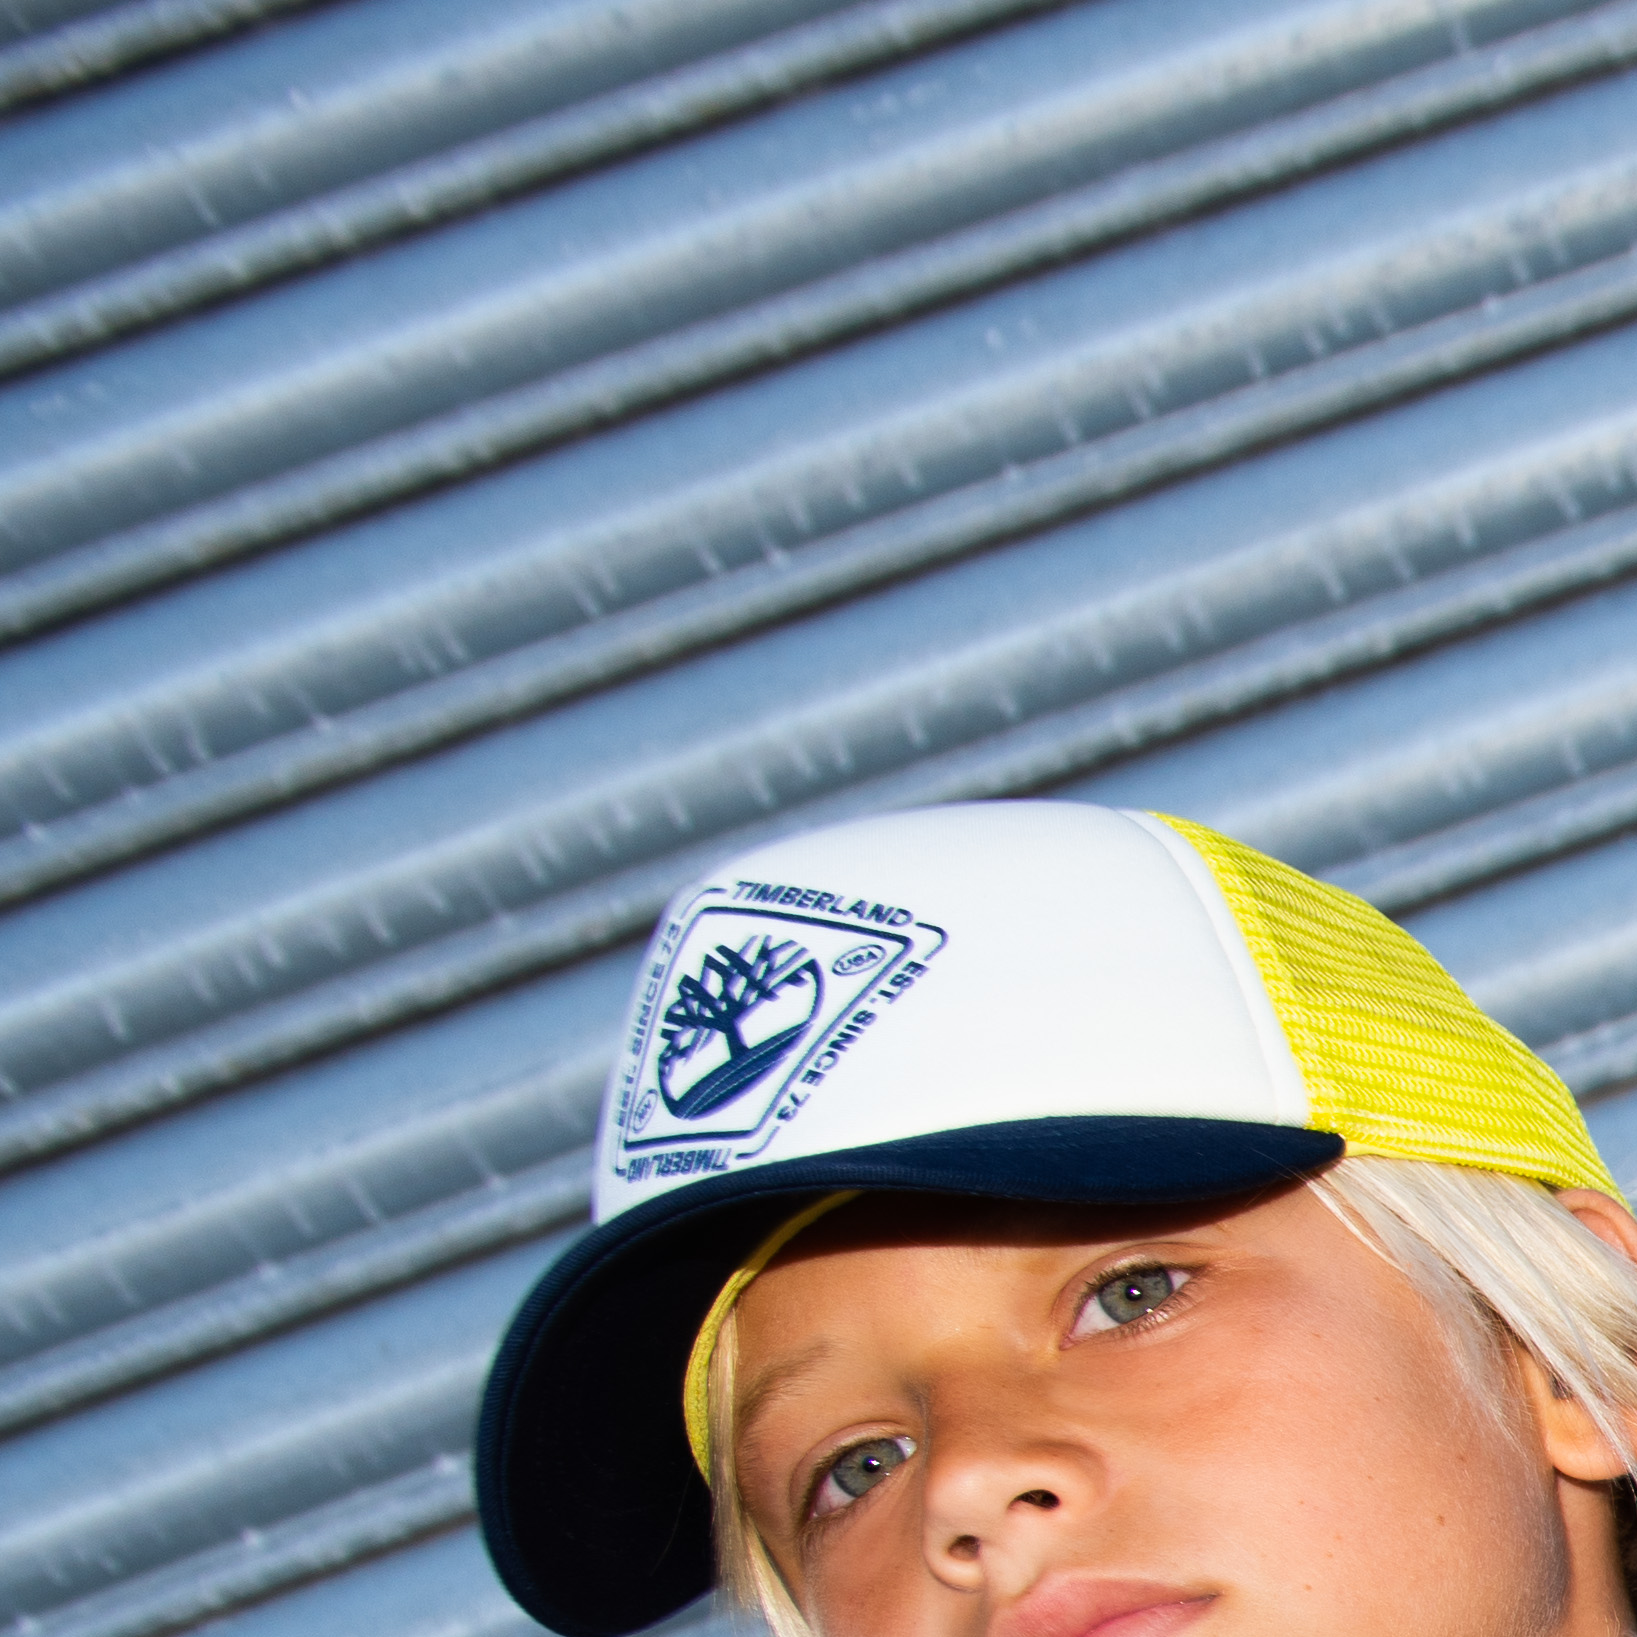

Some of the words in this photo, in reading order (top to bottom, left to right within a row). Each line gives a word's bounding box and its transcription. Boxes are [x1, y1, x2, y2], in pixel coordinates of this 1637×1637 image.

[732, 880, 914, 928] TIMBERLAND
[869, 960, 929, 1004] EST.
[801, 1010, 878, 1087] SINCE
[776, 1092, 811, 1122] 73
[627, 1148, 732, 1184] TIMBERLAND
